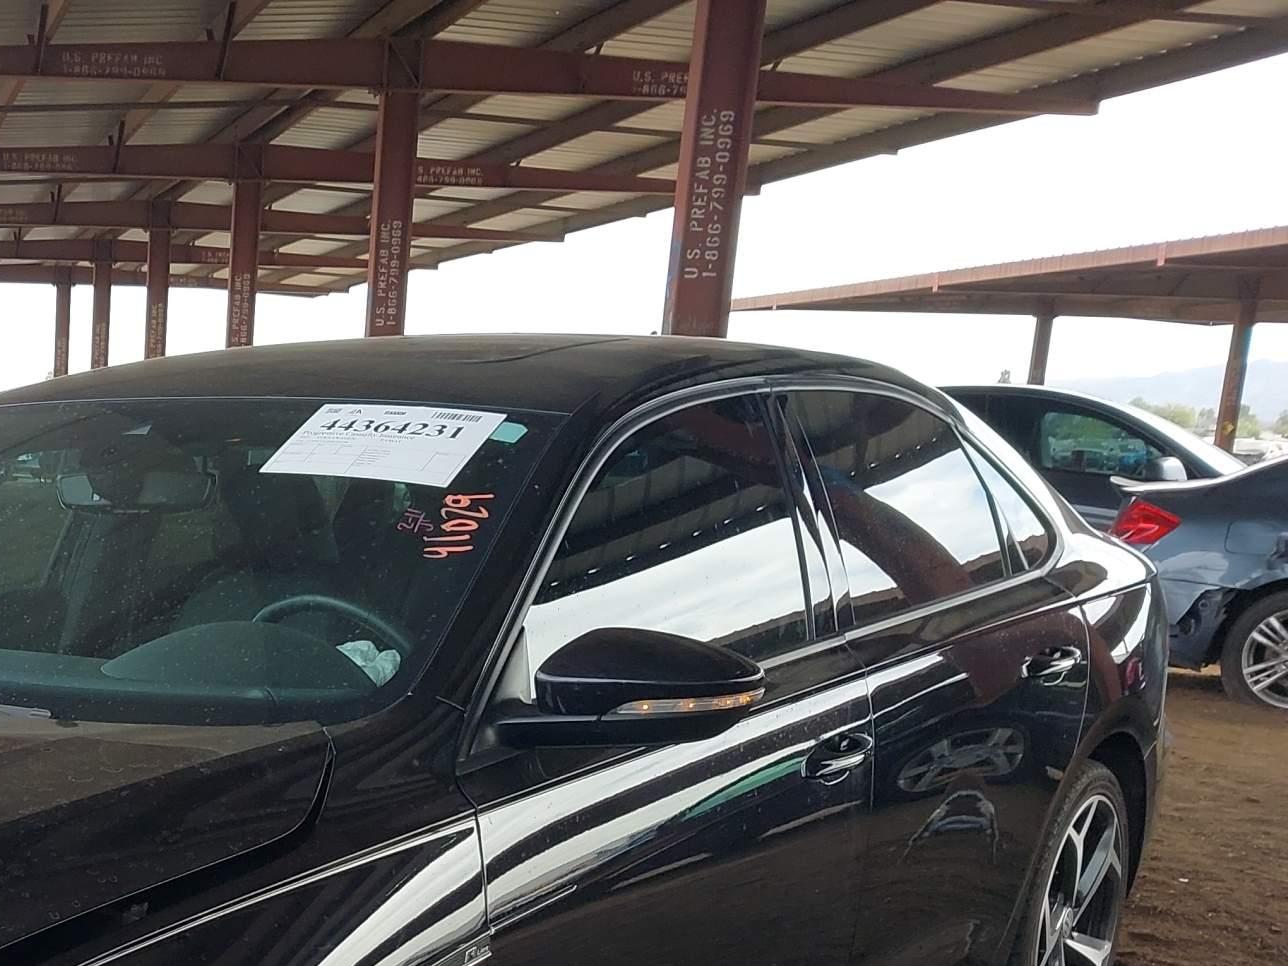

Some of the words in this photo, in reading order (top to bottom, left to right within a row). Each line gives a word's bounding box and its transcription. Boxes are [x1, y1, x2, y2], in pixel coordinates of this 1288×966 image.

[699, 109, 717, 145] INC.
[690, 156, 712, 232] PREFAB
[702, 110, 735, 278] 1-866-799-0969
[381, 219, 391, 243] INC.
[377, 249, 389, 297] PREFAB
[386, 220, 402, 326] 1-866-799-0969
[684, 243, 702, 279] U.S.
[376, 303, 386, 327] U.S.
[320, 418, 465, 440] 44364231
[423, 493, 494, 559] 41029
